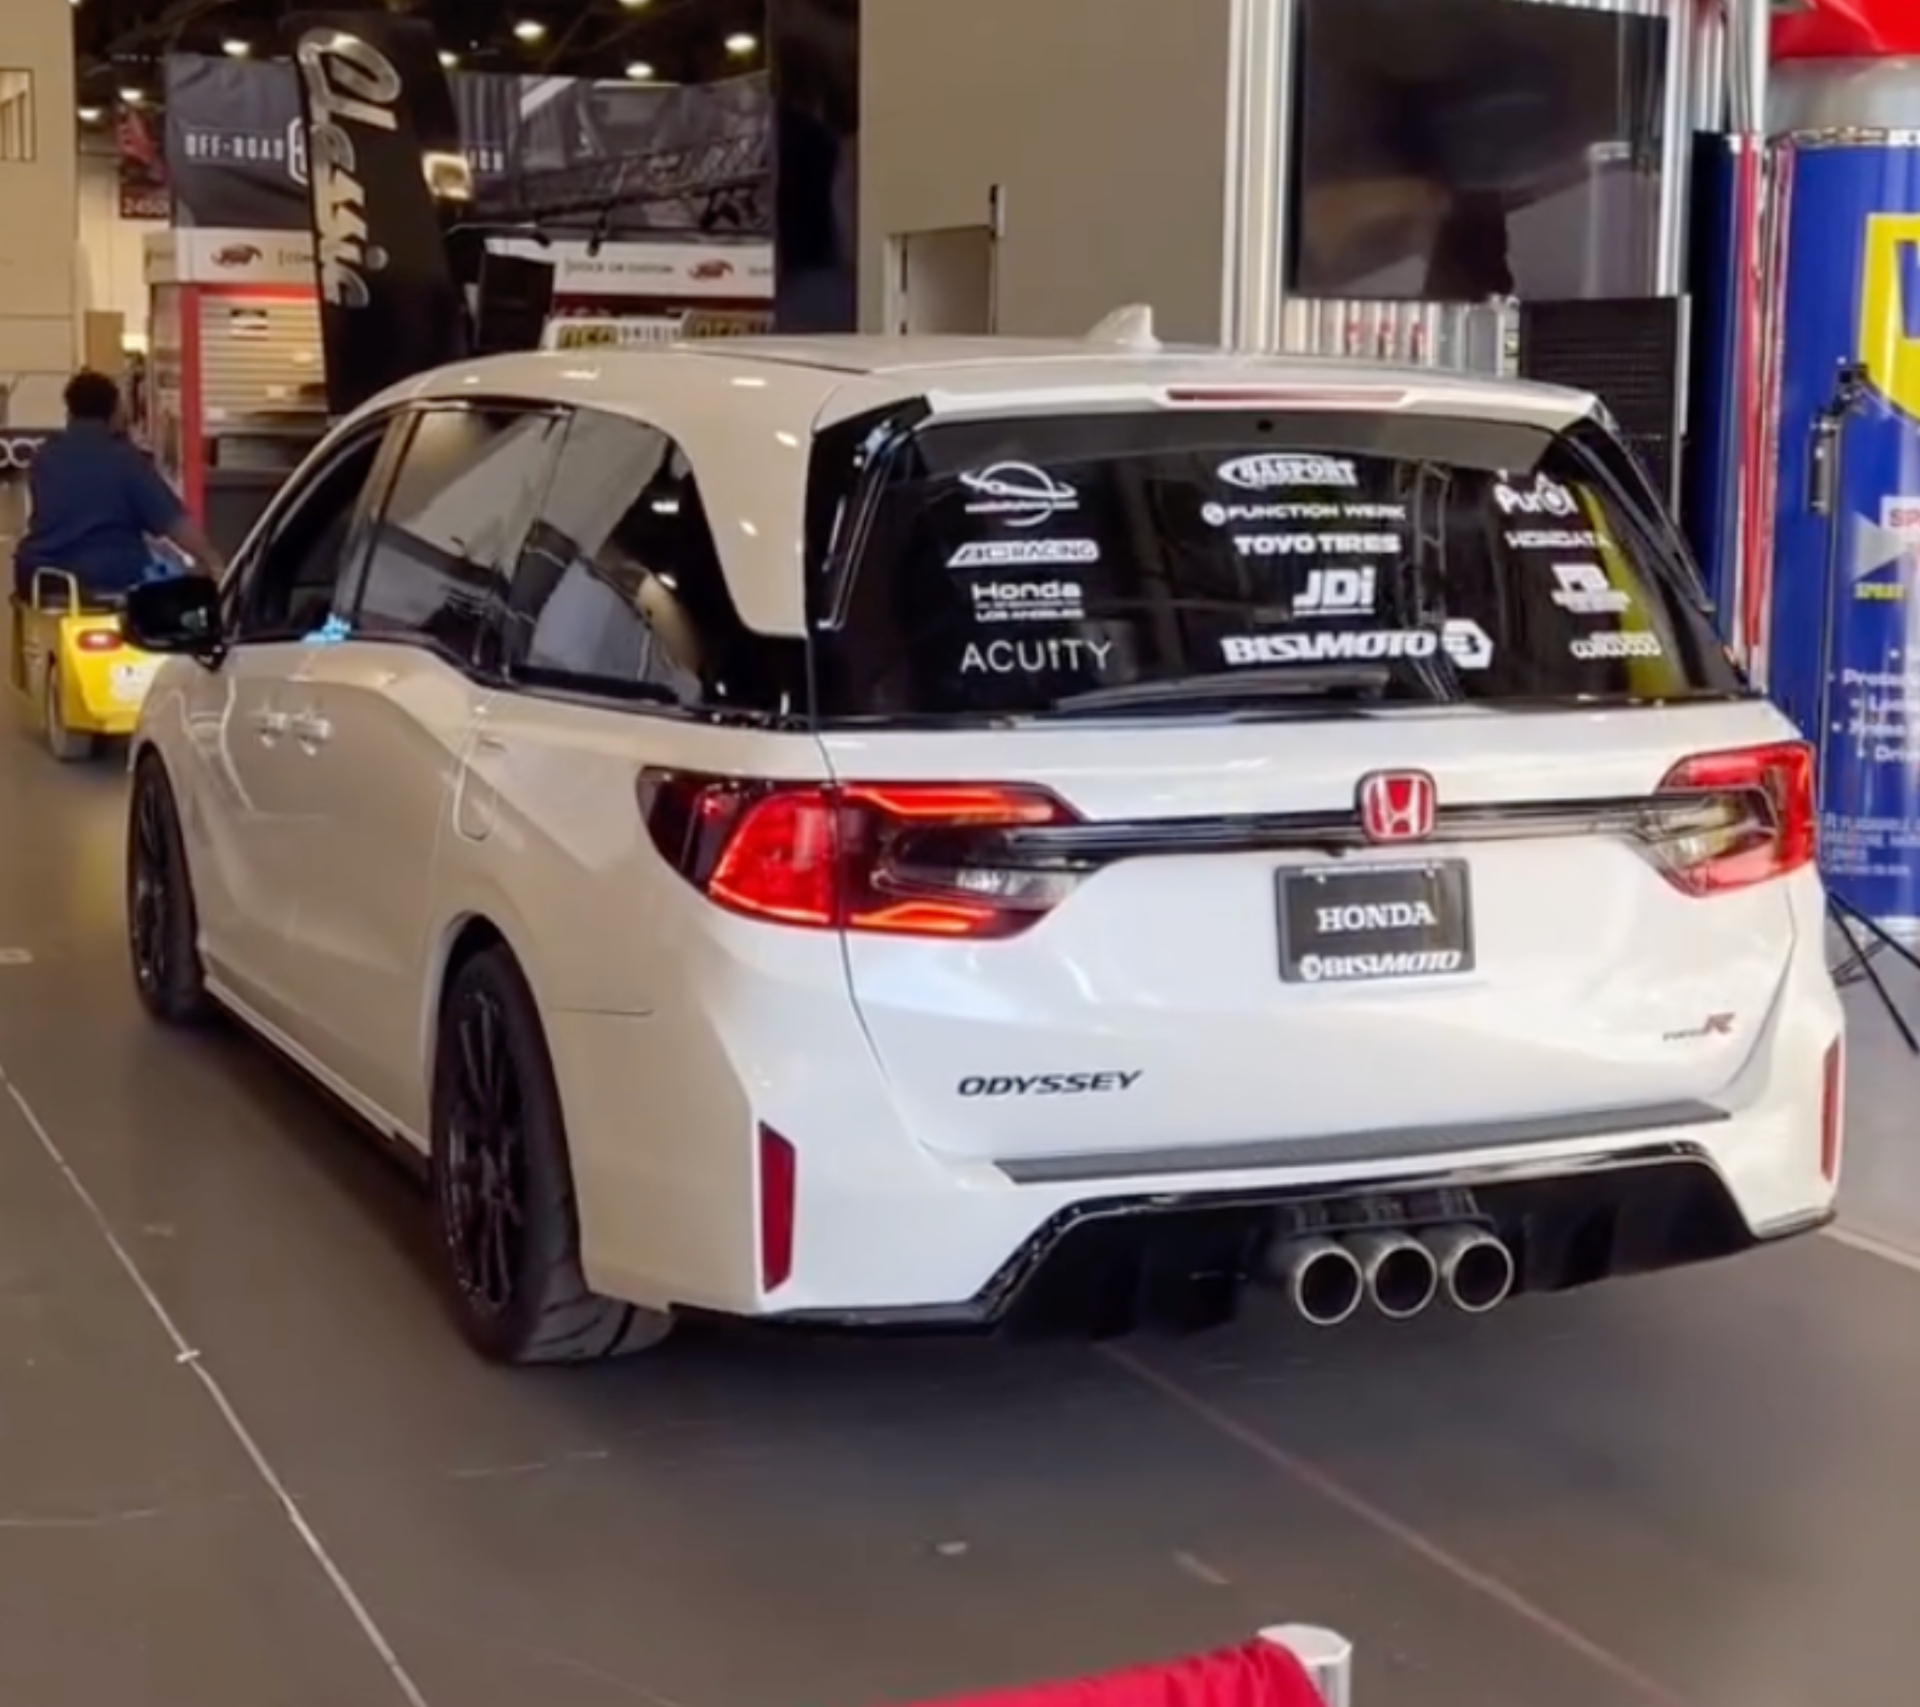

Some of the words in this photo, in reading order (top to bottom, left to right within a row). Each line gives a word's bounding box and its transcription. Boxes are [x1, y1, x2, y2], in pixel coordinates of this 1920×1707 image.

[185, 134, 284, 160] OFF-ROAD
[298, 27, 402, 308] Classic
[1228, 503, 1339, 520] FUNCTION
[1234, 533, 1315, 555] TOYO
[1317, 533, 1401, 554] TIRES
[970, 581, 1082, 600] Honda
[959, 639, 1114, 674] ACUITY
[1220, 630, 1437, 665] BISIMOTO
[1316, 902, 1438, 933] HONDA
[957, 1069, 1143, 1097] ODYSSEY
